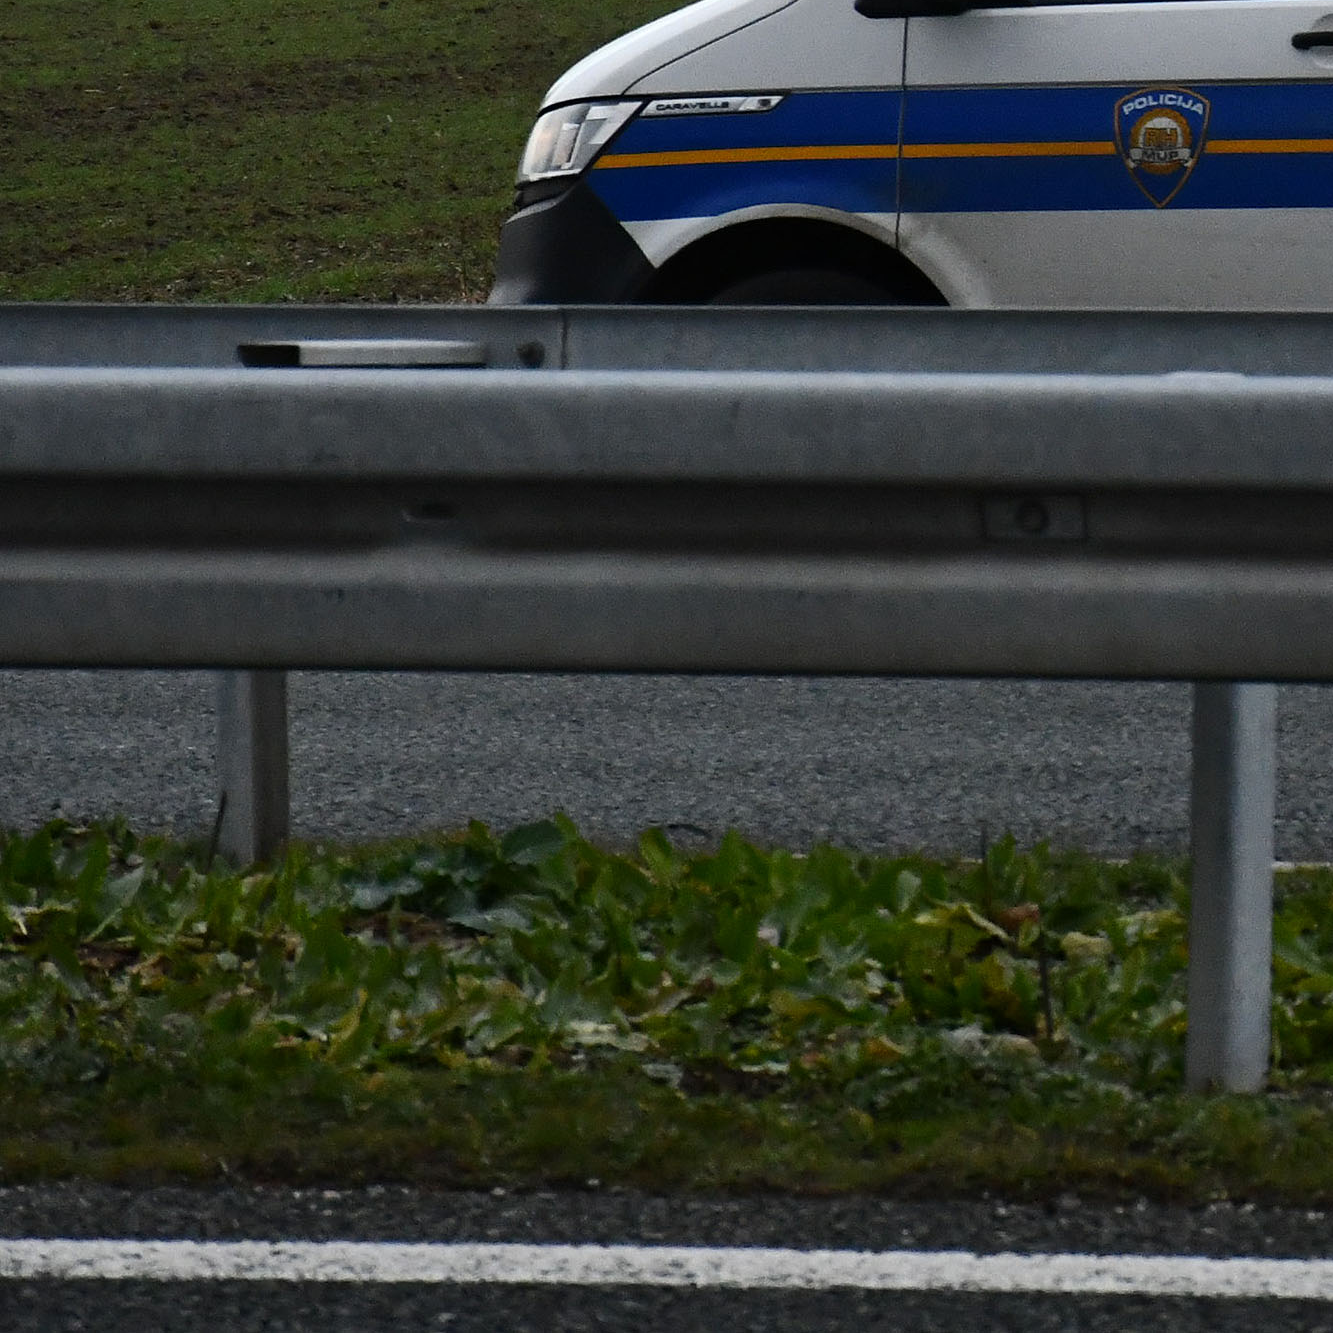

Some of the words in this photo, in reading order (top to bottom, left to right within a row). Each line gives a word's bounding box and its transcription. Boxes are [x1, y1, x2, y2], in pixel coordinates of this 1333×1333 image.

[656, 101, 729, 111] CARAVELLE
[1122, 93, 1204, 115] POLICIJA
[1142, 150, 1179, 162] MUP
